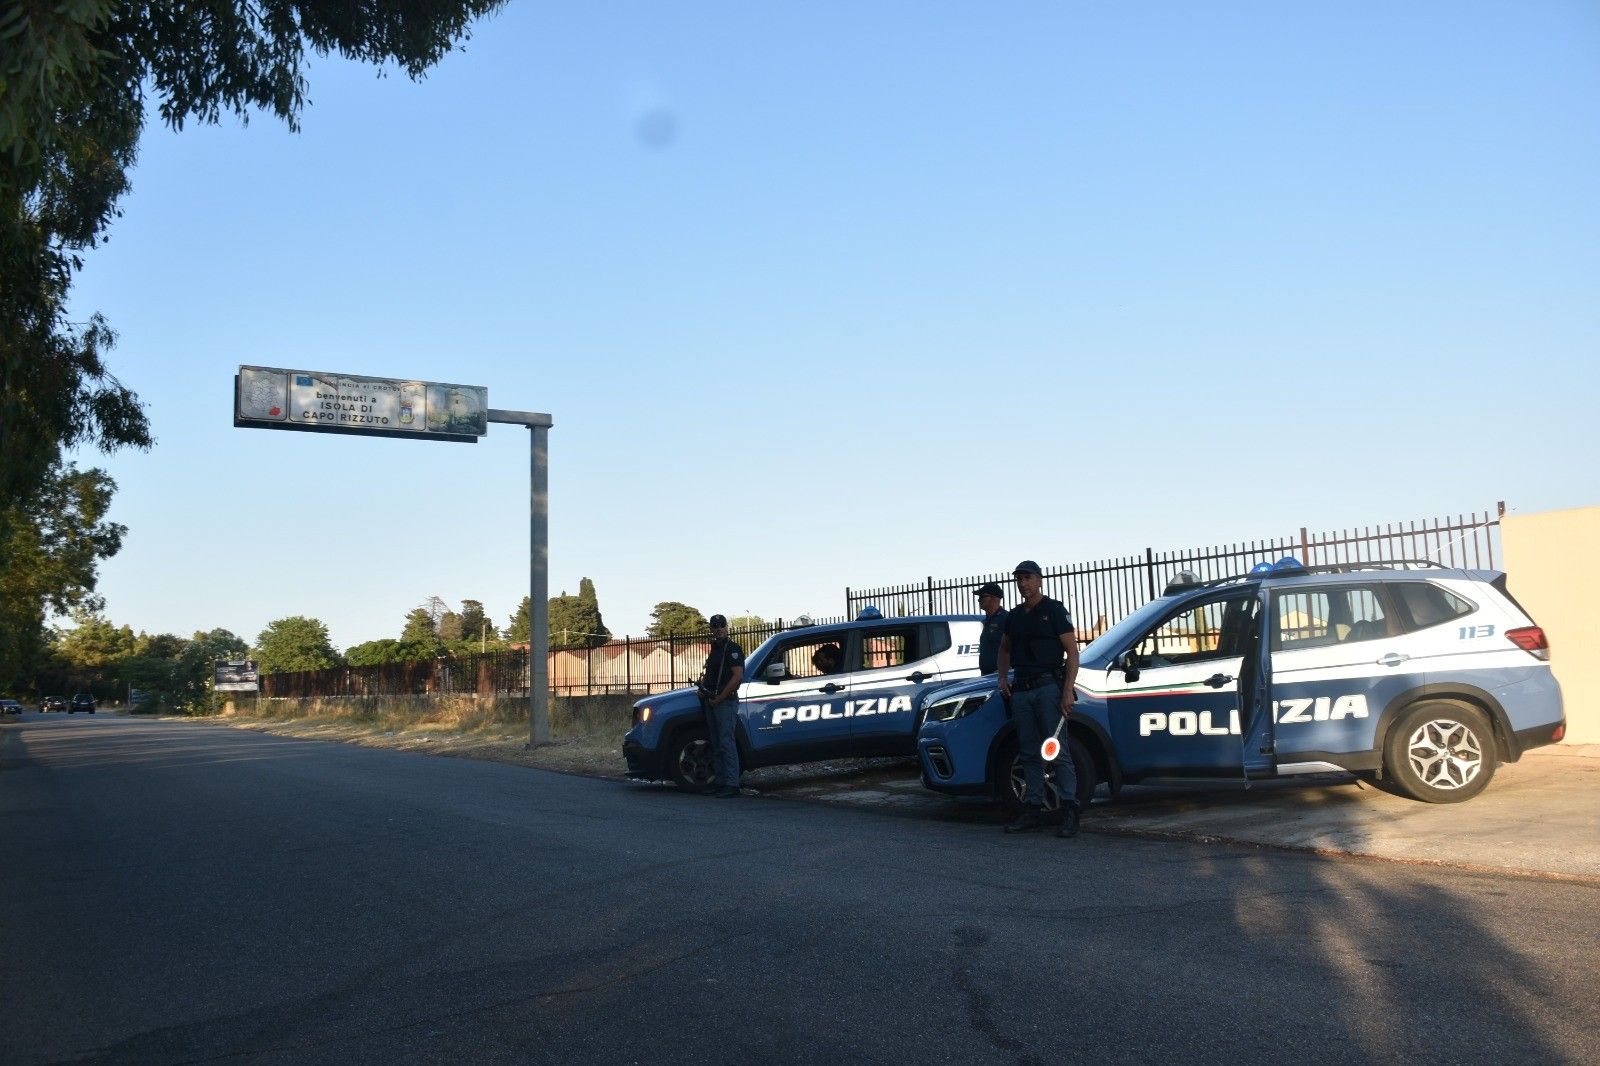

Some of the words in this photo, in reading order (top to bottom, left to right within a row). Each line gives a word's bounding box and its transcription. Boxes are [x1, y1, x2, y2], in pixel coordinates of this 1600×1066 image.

[316, 392, 367, 402] benvenuti
[320, 402, 356, 411] ISOLA
[361, 405, 373, 413] DI
[302, 411, 335, 420] CAPO
[340, 413, 389, 424] RIZZUTO
[1458, 625, 1495, 640] 113
[771, 694, 913, 725] POLIZIA
